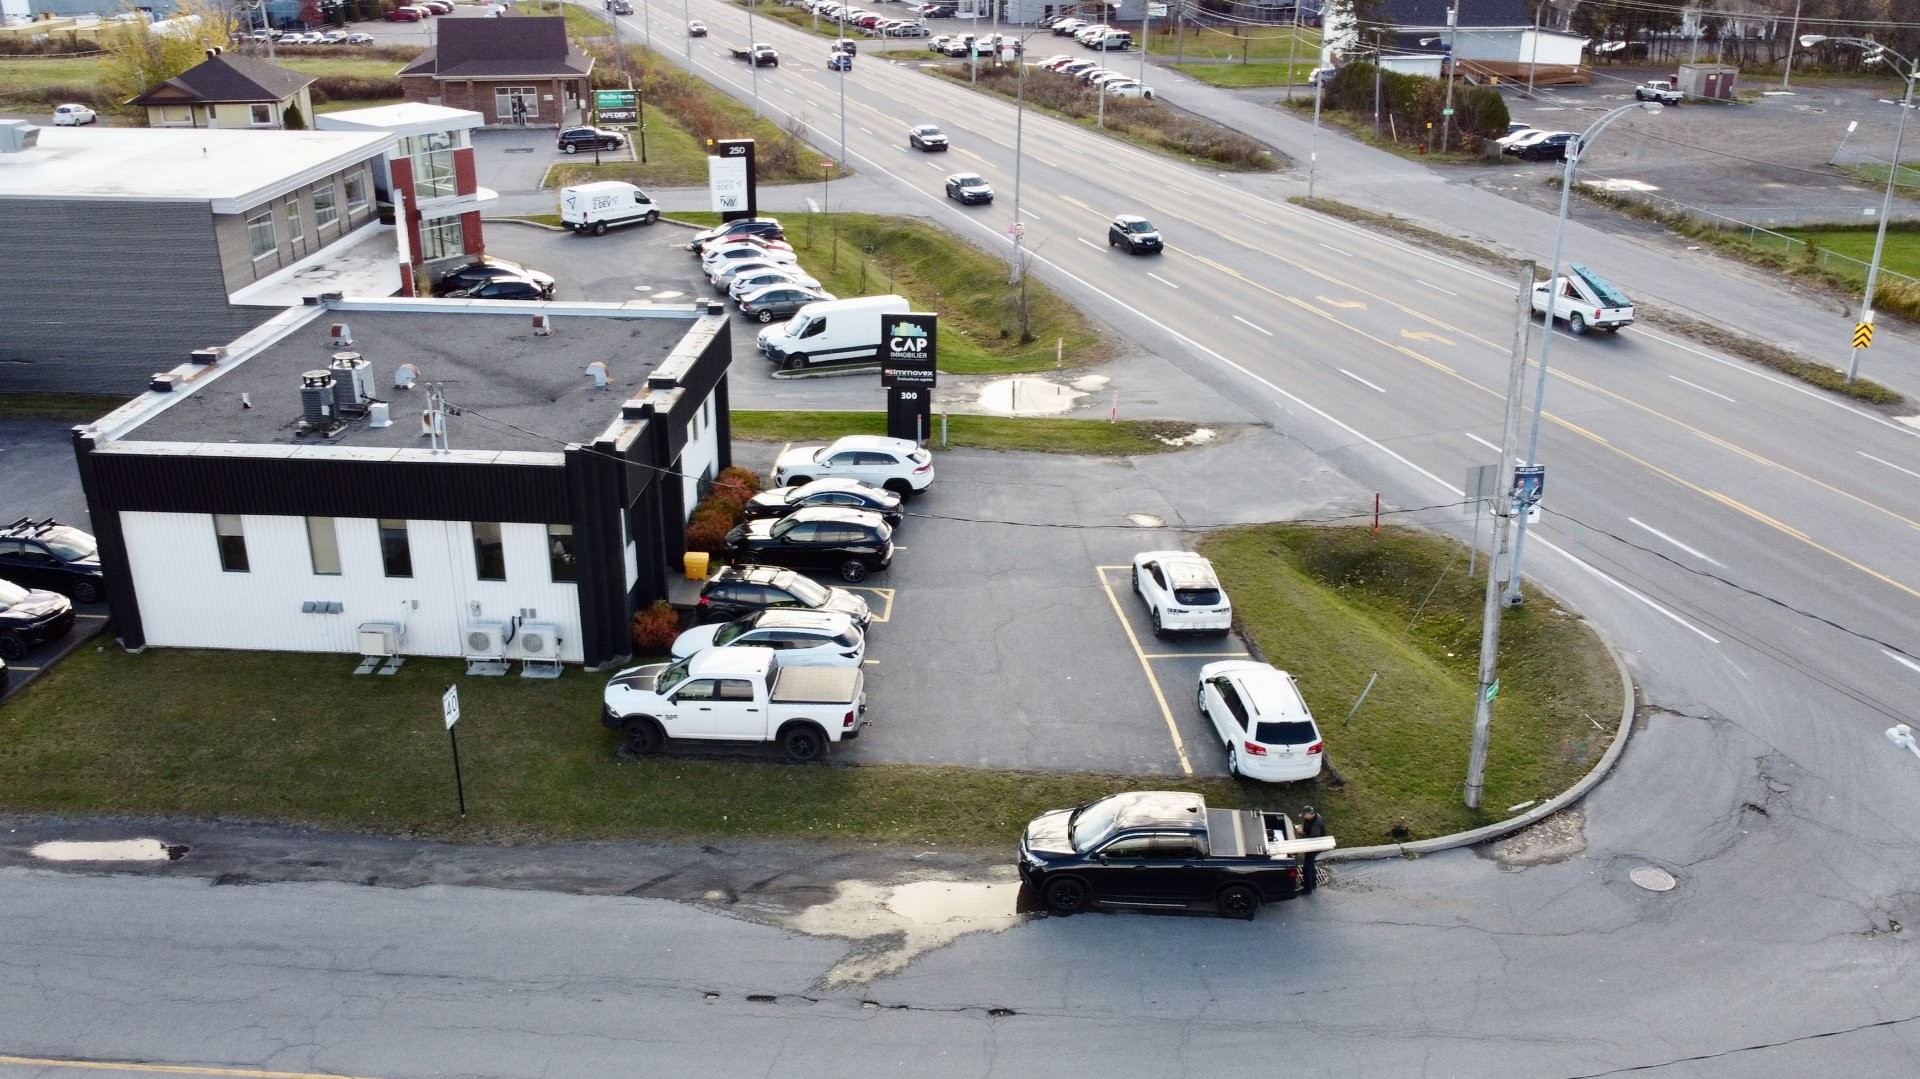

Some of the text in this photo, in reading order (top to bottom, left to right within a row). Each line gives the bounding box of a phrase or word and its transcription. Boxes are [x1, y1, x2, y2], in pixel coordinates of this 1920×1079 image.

[598, 200, 611, 208] DEV
[890, 337, 928, 352] CAP
[446, 694, 458, 716] 40
